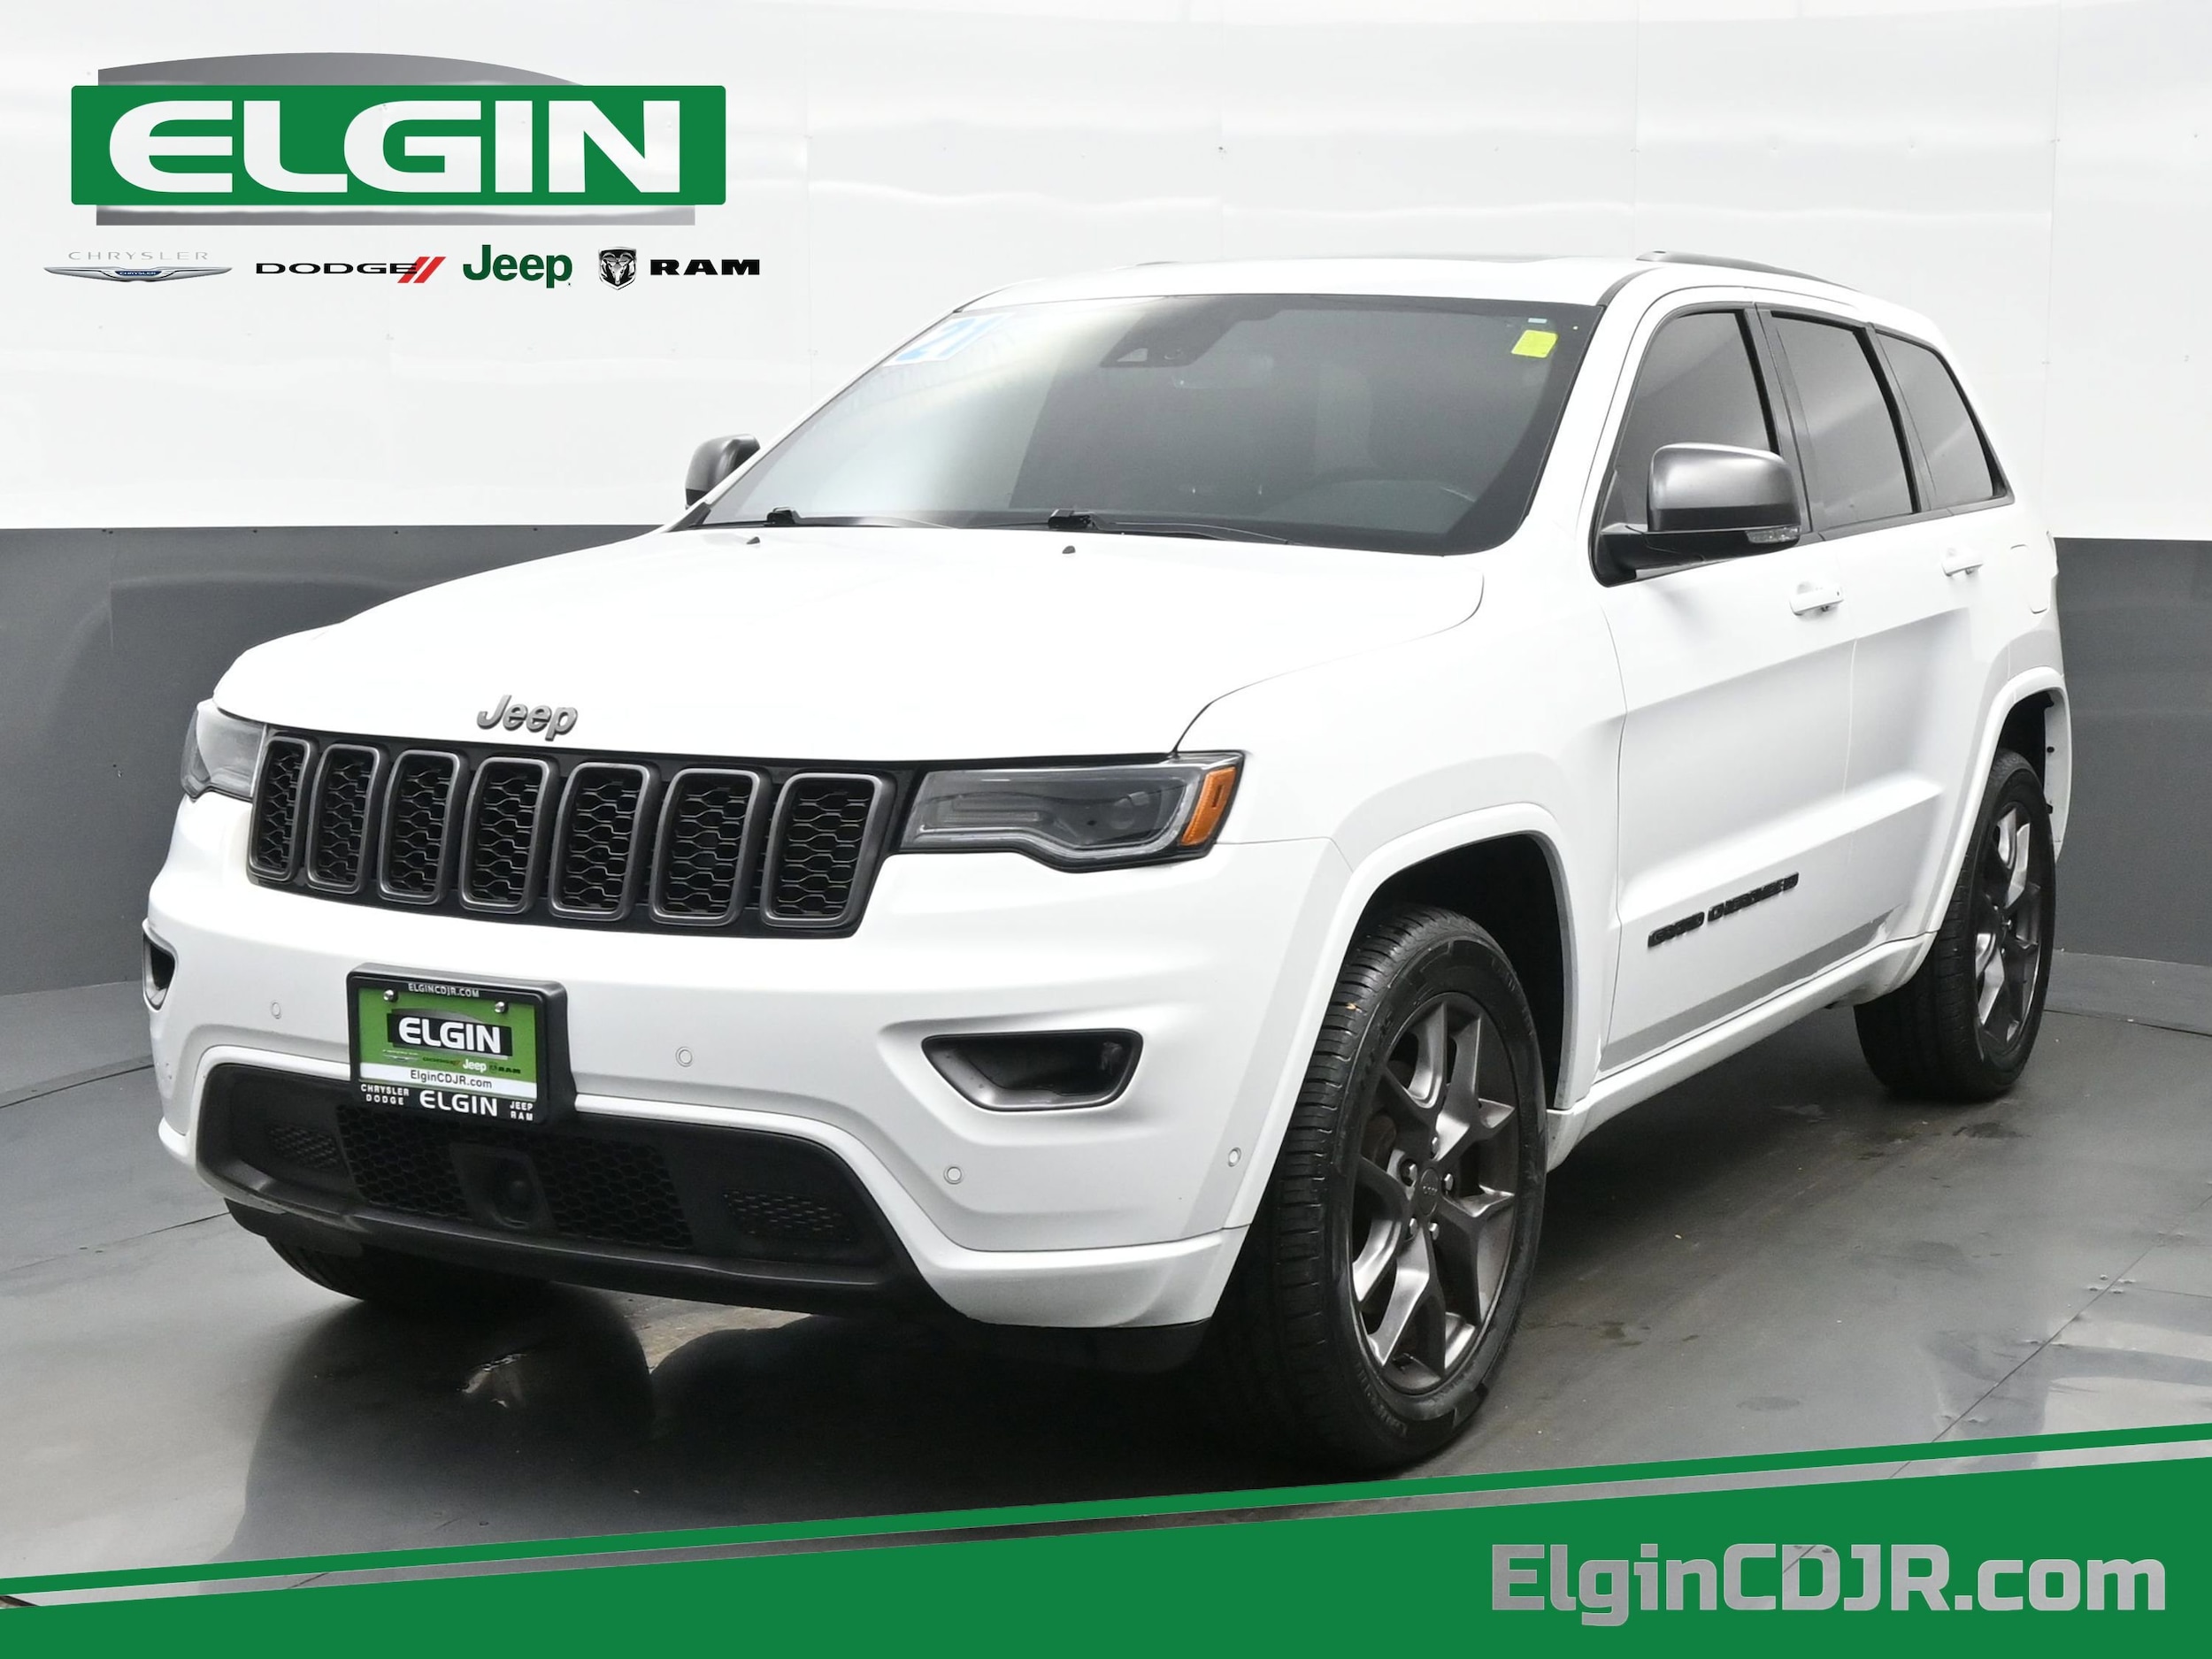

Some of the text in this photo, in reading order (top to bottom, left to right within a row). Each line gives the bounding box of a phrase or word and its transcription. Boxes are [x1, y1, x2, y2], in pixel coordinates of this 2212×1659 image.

[476, 694, 579, 742] Jeep
[408, 983, 480, 998] ELGINCDJR.COM
[398, 1016, 501, 1054] ELGIN
[463, 1059, 487, 1072] Jeep
[410, 1069, 493, 1088] ElginCDJR.com
[360, 1083, 410, 1096] CHRYSLER
[366, 1094, 404, 1105] DODGE
[419, 1089, 498, 1117] ELGIN
[510, 1100, 534, 1110] JEEP
[511, 1111, 534, 1121] RAM
